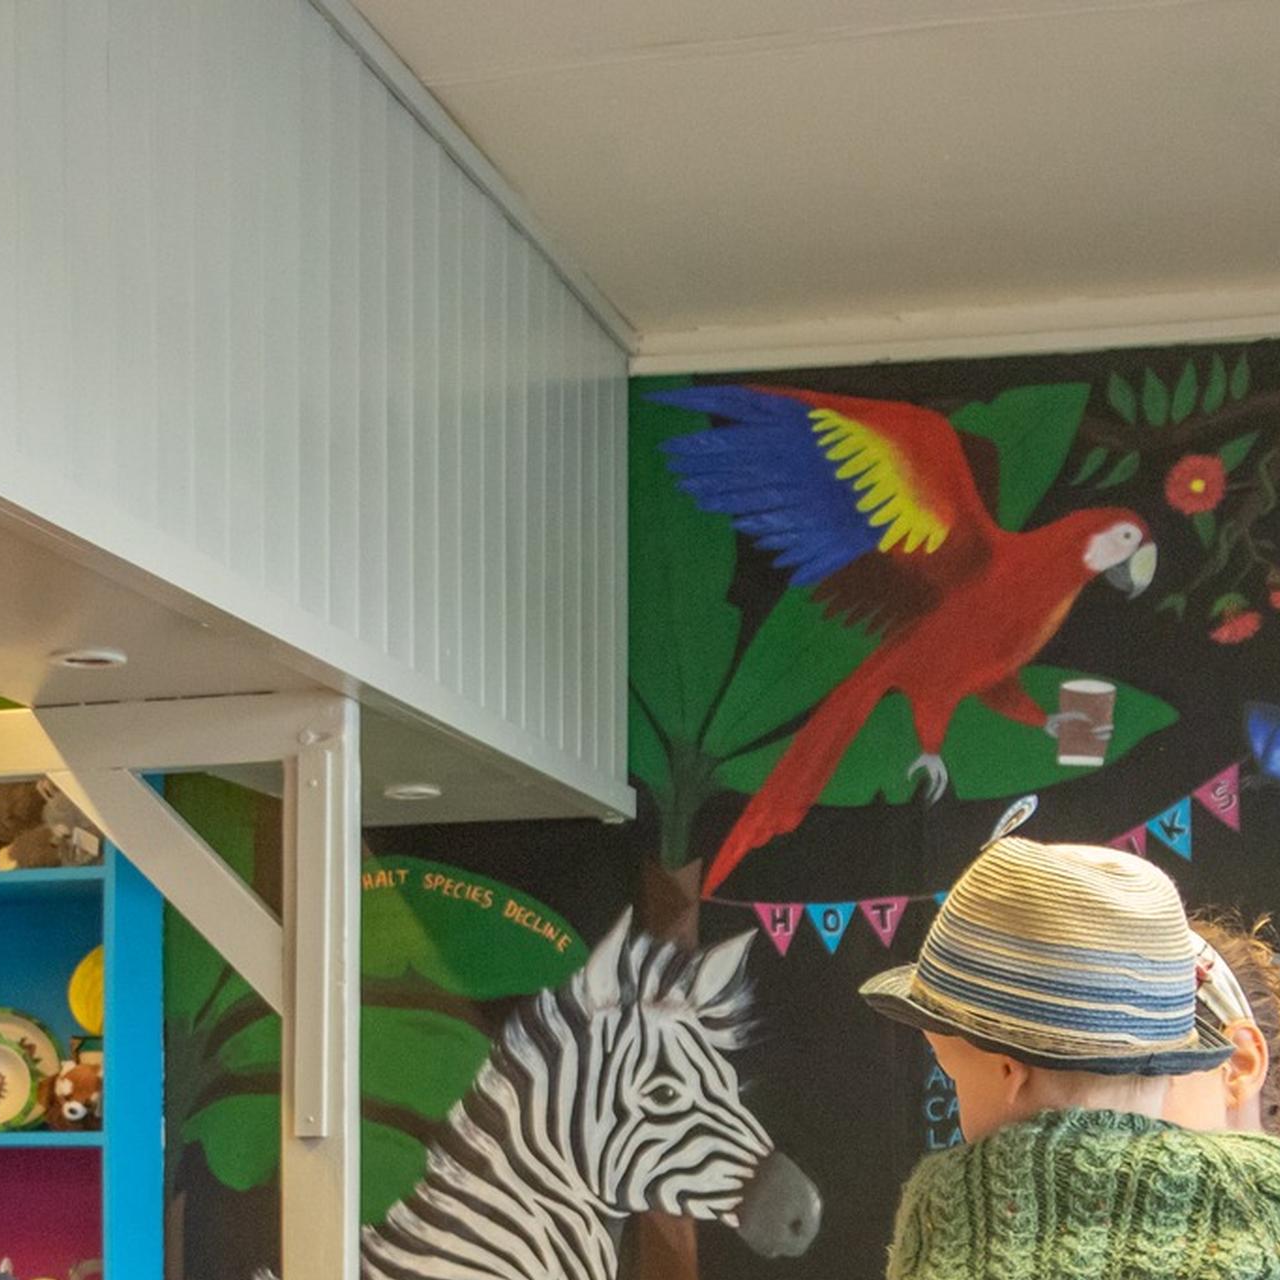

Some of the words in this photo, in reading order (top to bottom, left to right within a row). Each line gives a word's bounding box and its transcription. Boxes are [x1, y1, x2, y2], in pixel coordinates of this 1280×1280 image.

[361, 868, 410, 892] HALT
[423, 872, 495, 909] SPECIES
[503, 900, 573, 953] DECLINE
[770, 903, 899, 938] HOT
